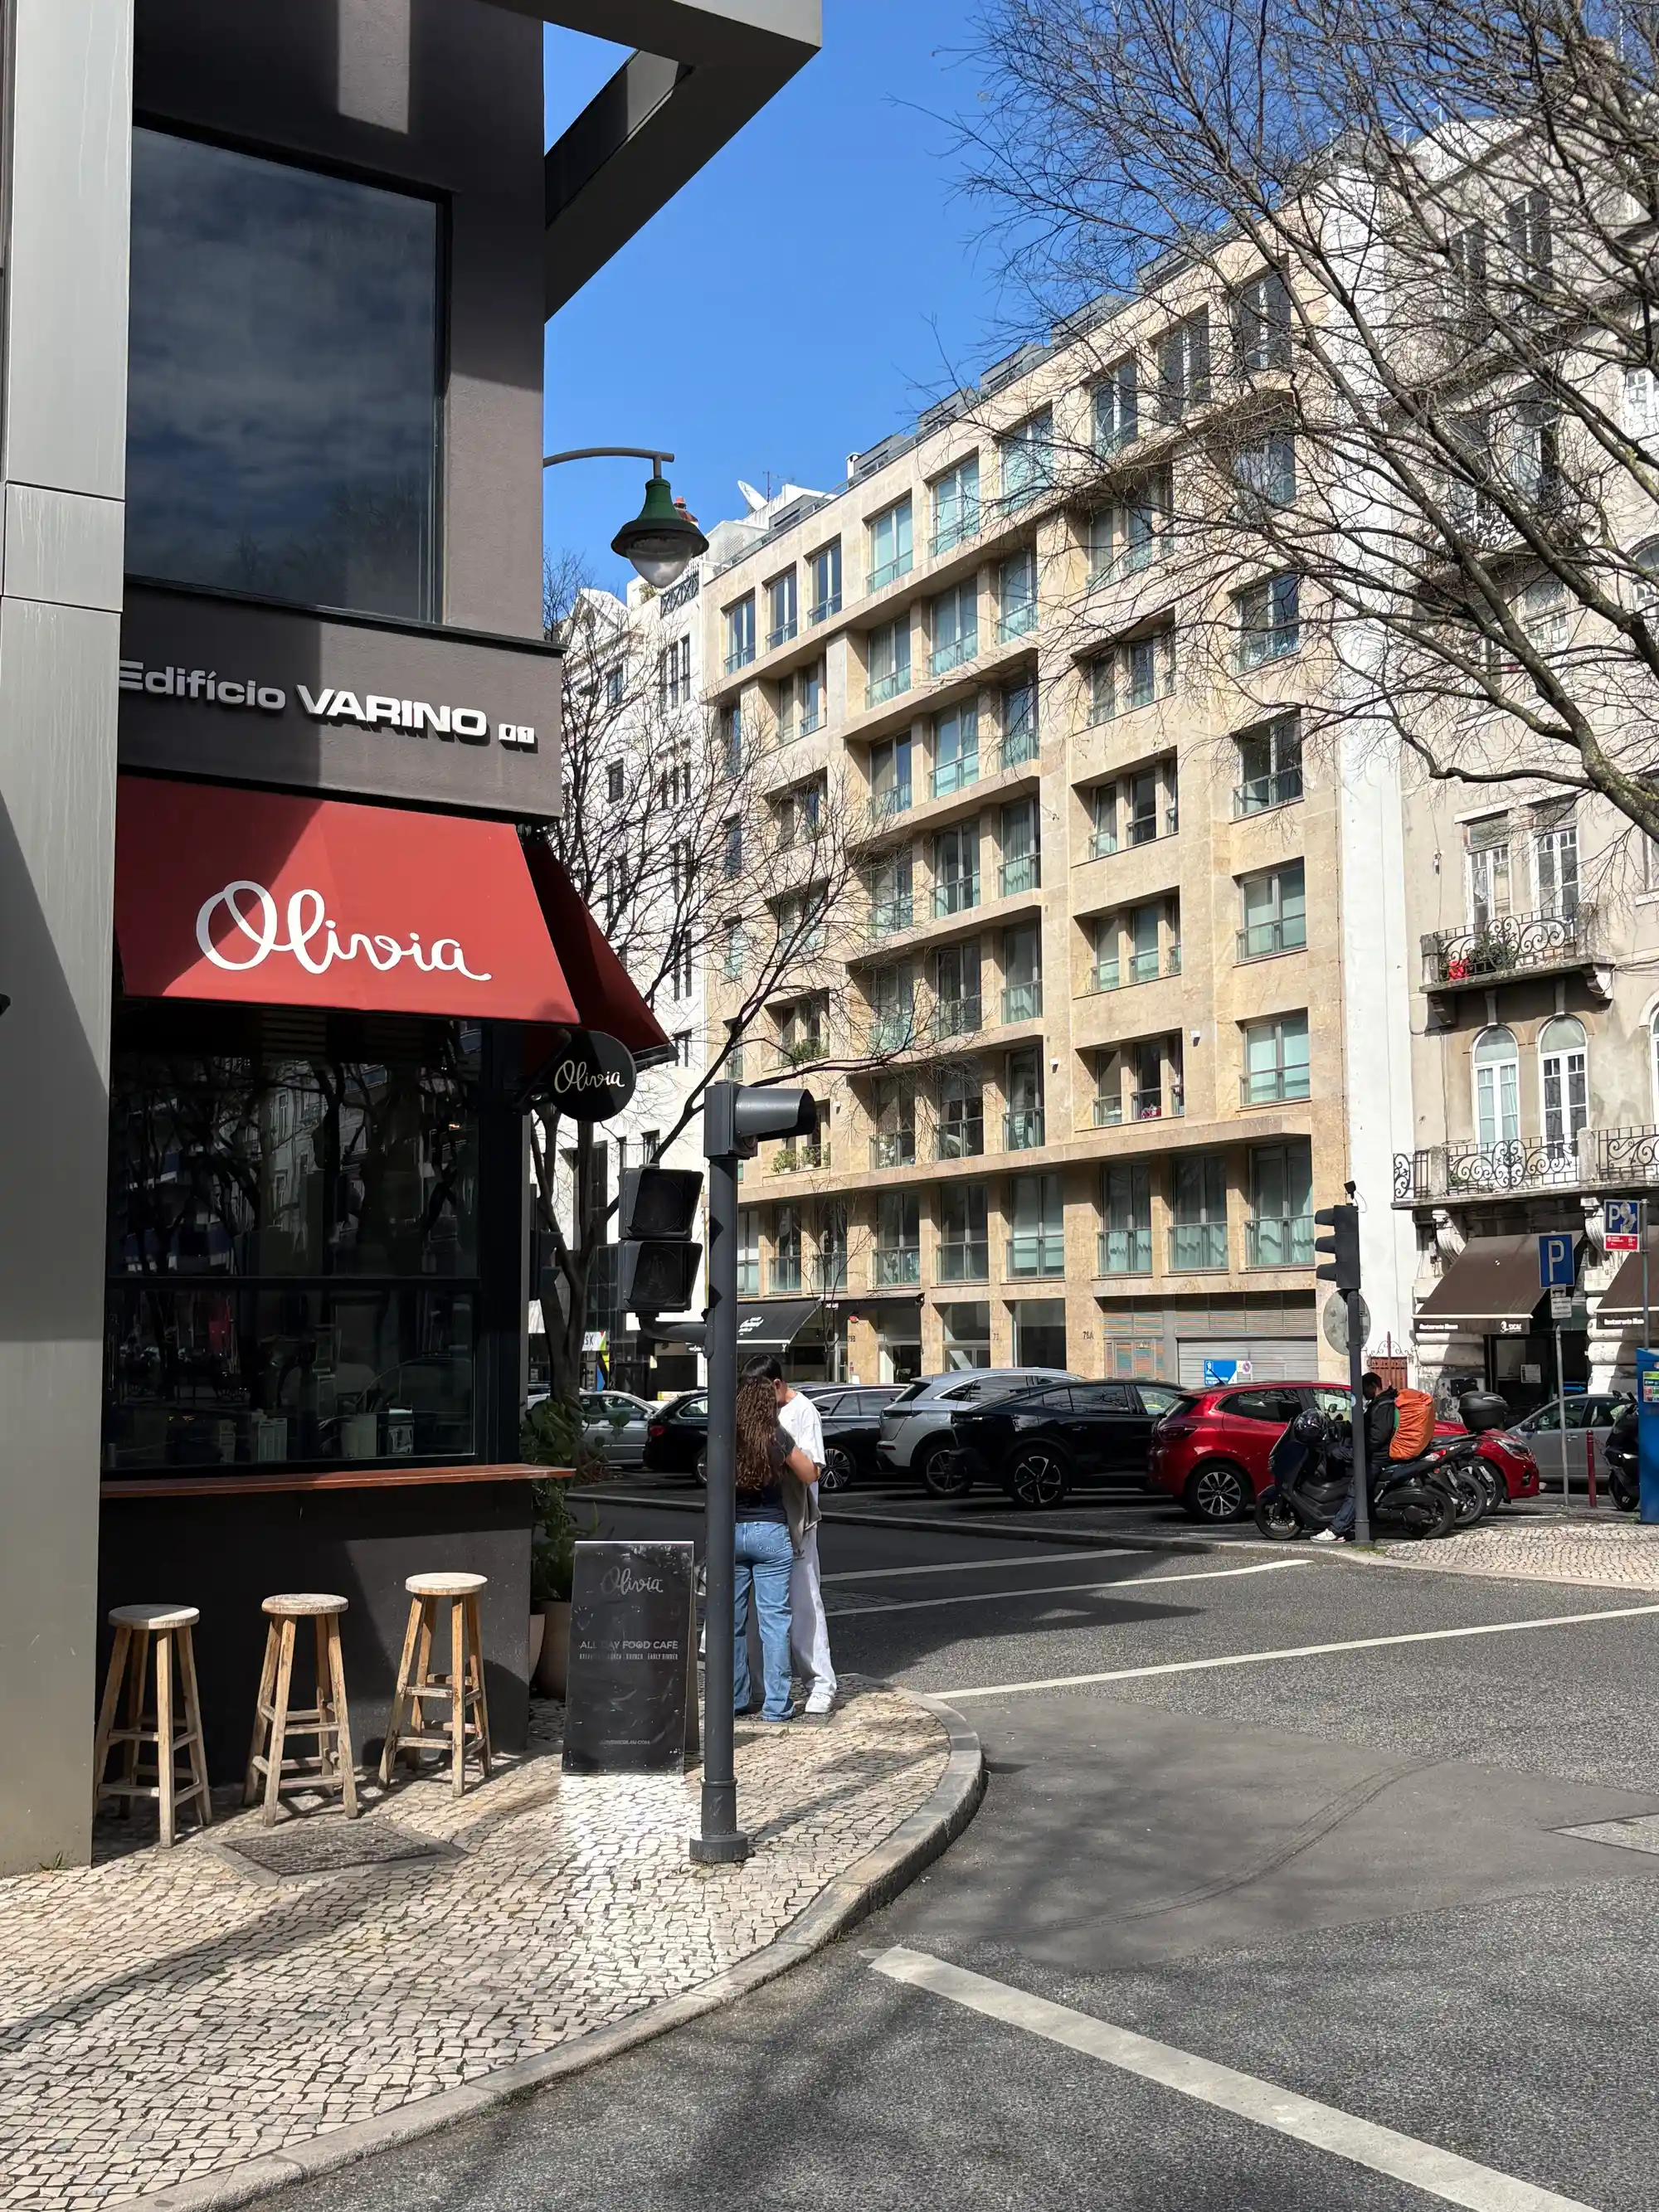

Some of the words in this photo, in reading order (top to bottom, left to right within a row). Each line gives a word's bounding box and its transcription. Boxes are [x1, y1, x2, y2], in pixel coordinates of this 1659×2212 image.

[119, 659, 285, 710] Edifício
[296, 684, 486, 737] VARINO
[196, 880, 493, 981] Olivia
[554, 1059, 625, 1093] Olivia
[1548, 1240, 1564, 1282] P
[601, 1566, 664, 1595] Olivia
[580, 1641, 597, 1649] ALL
[622, 1641, 651, 1650] FOOD
